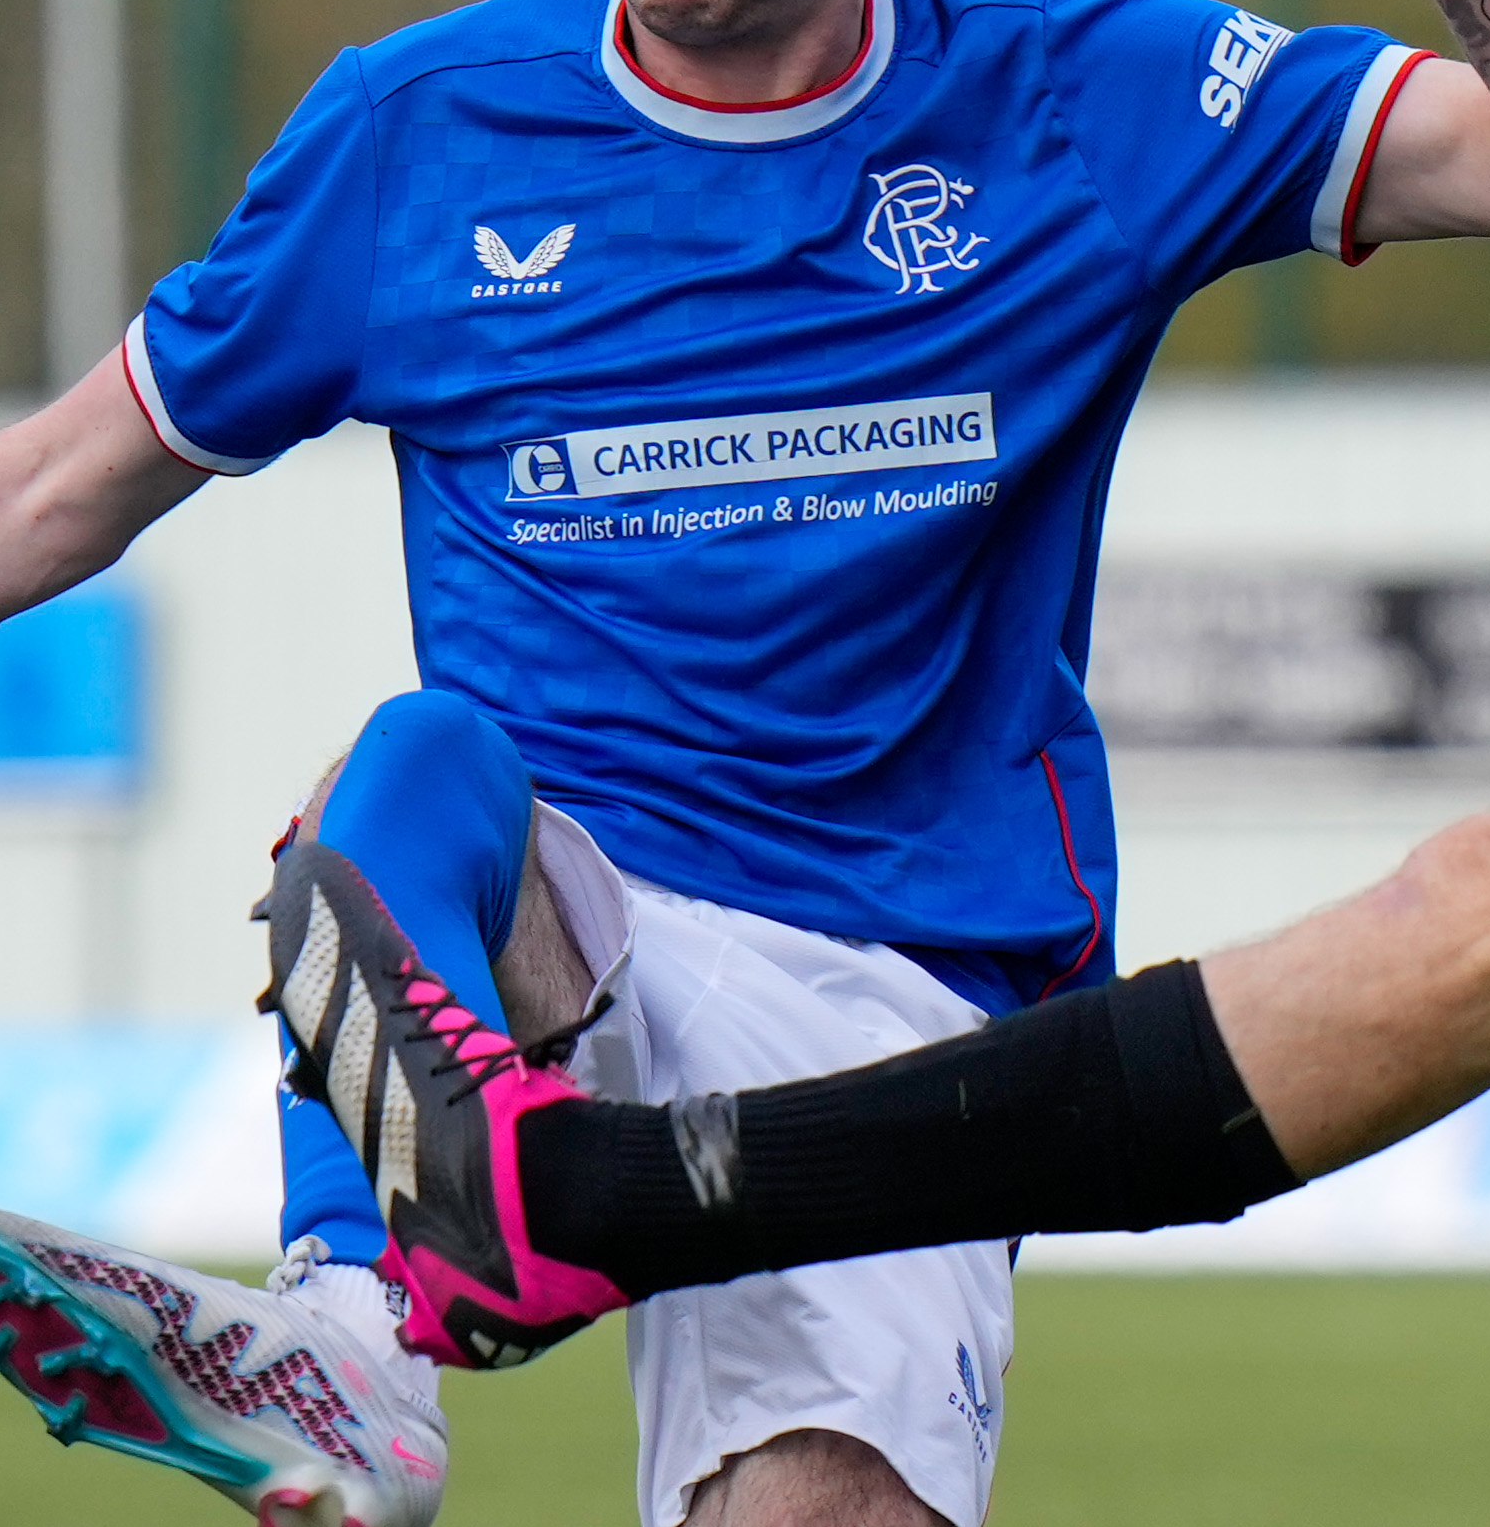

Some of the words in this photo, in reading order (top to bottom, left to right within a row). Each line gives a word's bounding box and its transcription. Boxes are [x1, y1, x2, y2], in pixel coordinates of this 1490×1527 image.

[1199, 9, 1284, 128] SEK
[471, 280, 563, 299] CASTORE
[593, 432, 755, 477] CARRICK
[767, 411, 982, 461] PACKAGING
[506, 514, 615, 545] Specialist
[621, 512, 644, 537] in
[652, 504, 764, 539] Injection
[772, 496, 794, 522] &
[801, 493, 866, 522] Blow
[873, 480, 998, 515] Moulding
